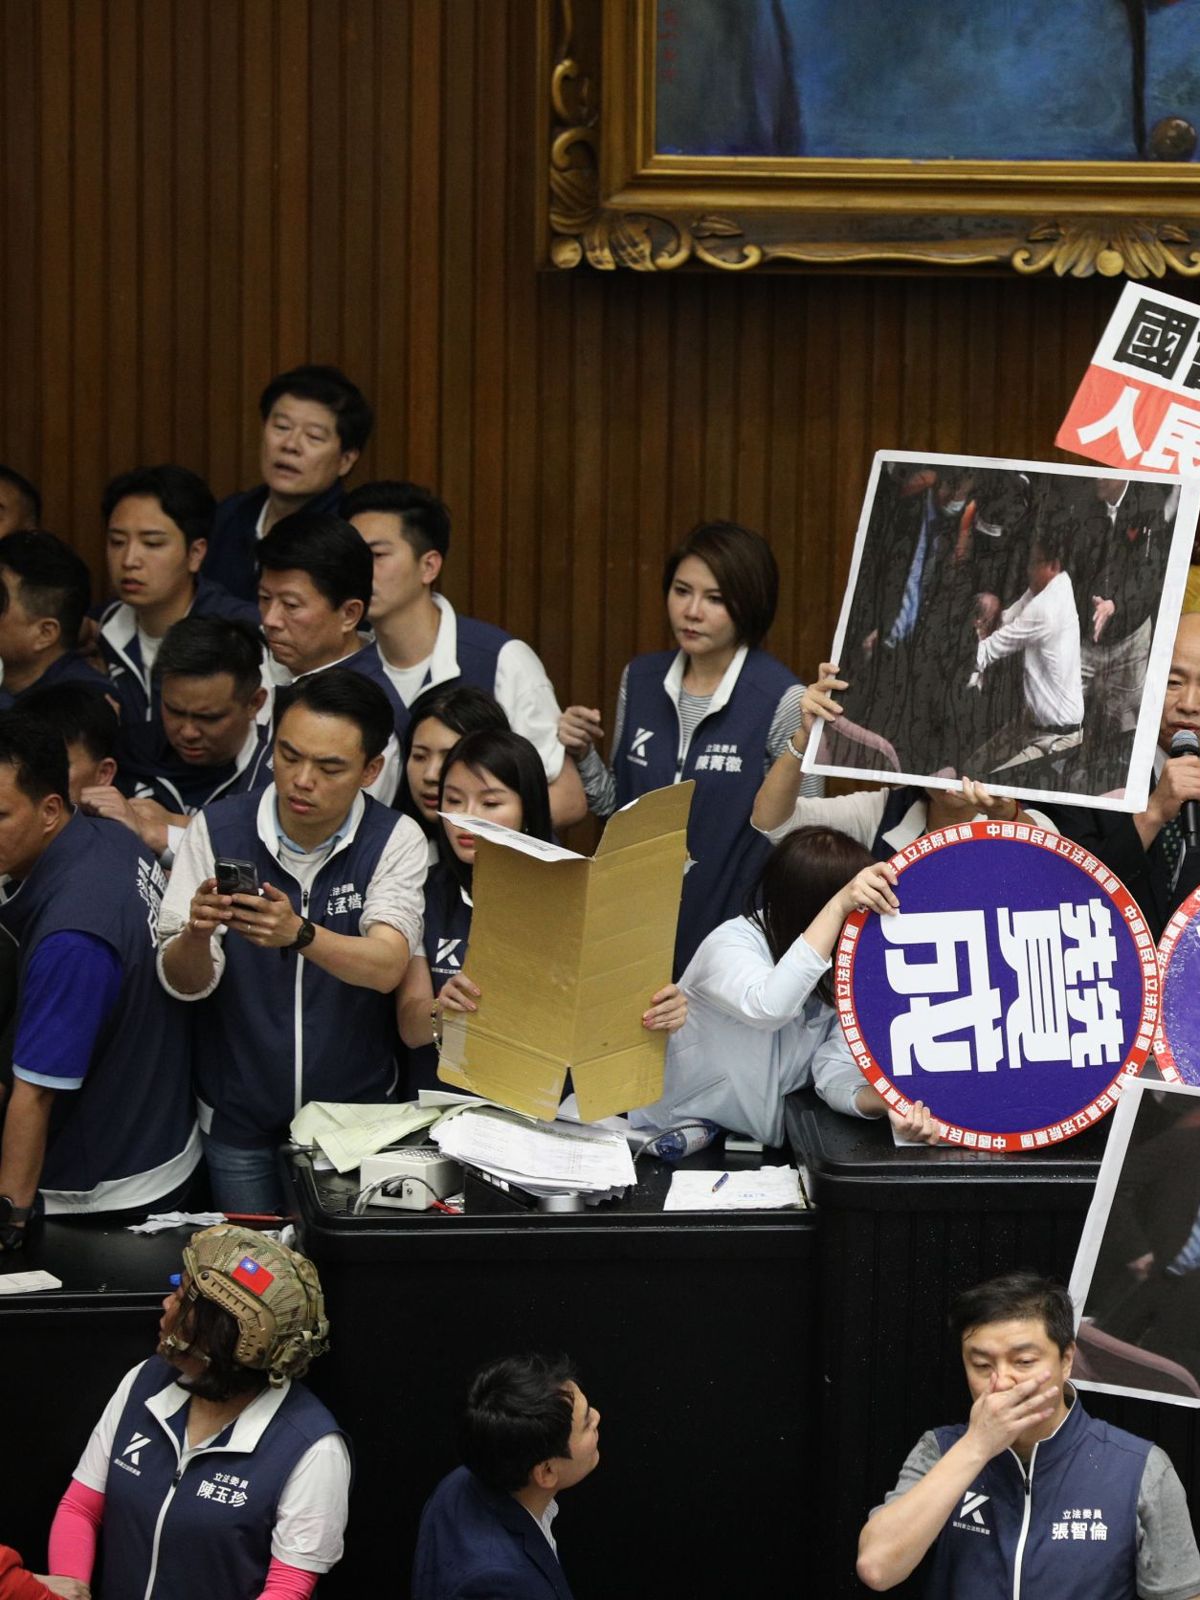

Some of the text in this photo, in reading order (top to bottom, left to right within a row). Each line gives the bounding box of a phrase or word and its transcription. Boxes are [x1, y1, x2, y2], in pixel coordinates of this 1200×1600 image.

[880, 898, 1124, 1077] 贊成
[213, 1472, 249, 1489] 立法委員
[196, 1480, 248, 1508] 陳玉珍
[1062, 1508, 1103, 1520] 立法委員
[1052, 1521, 1108, 1541] 張智倫
